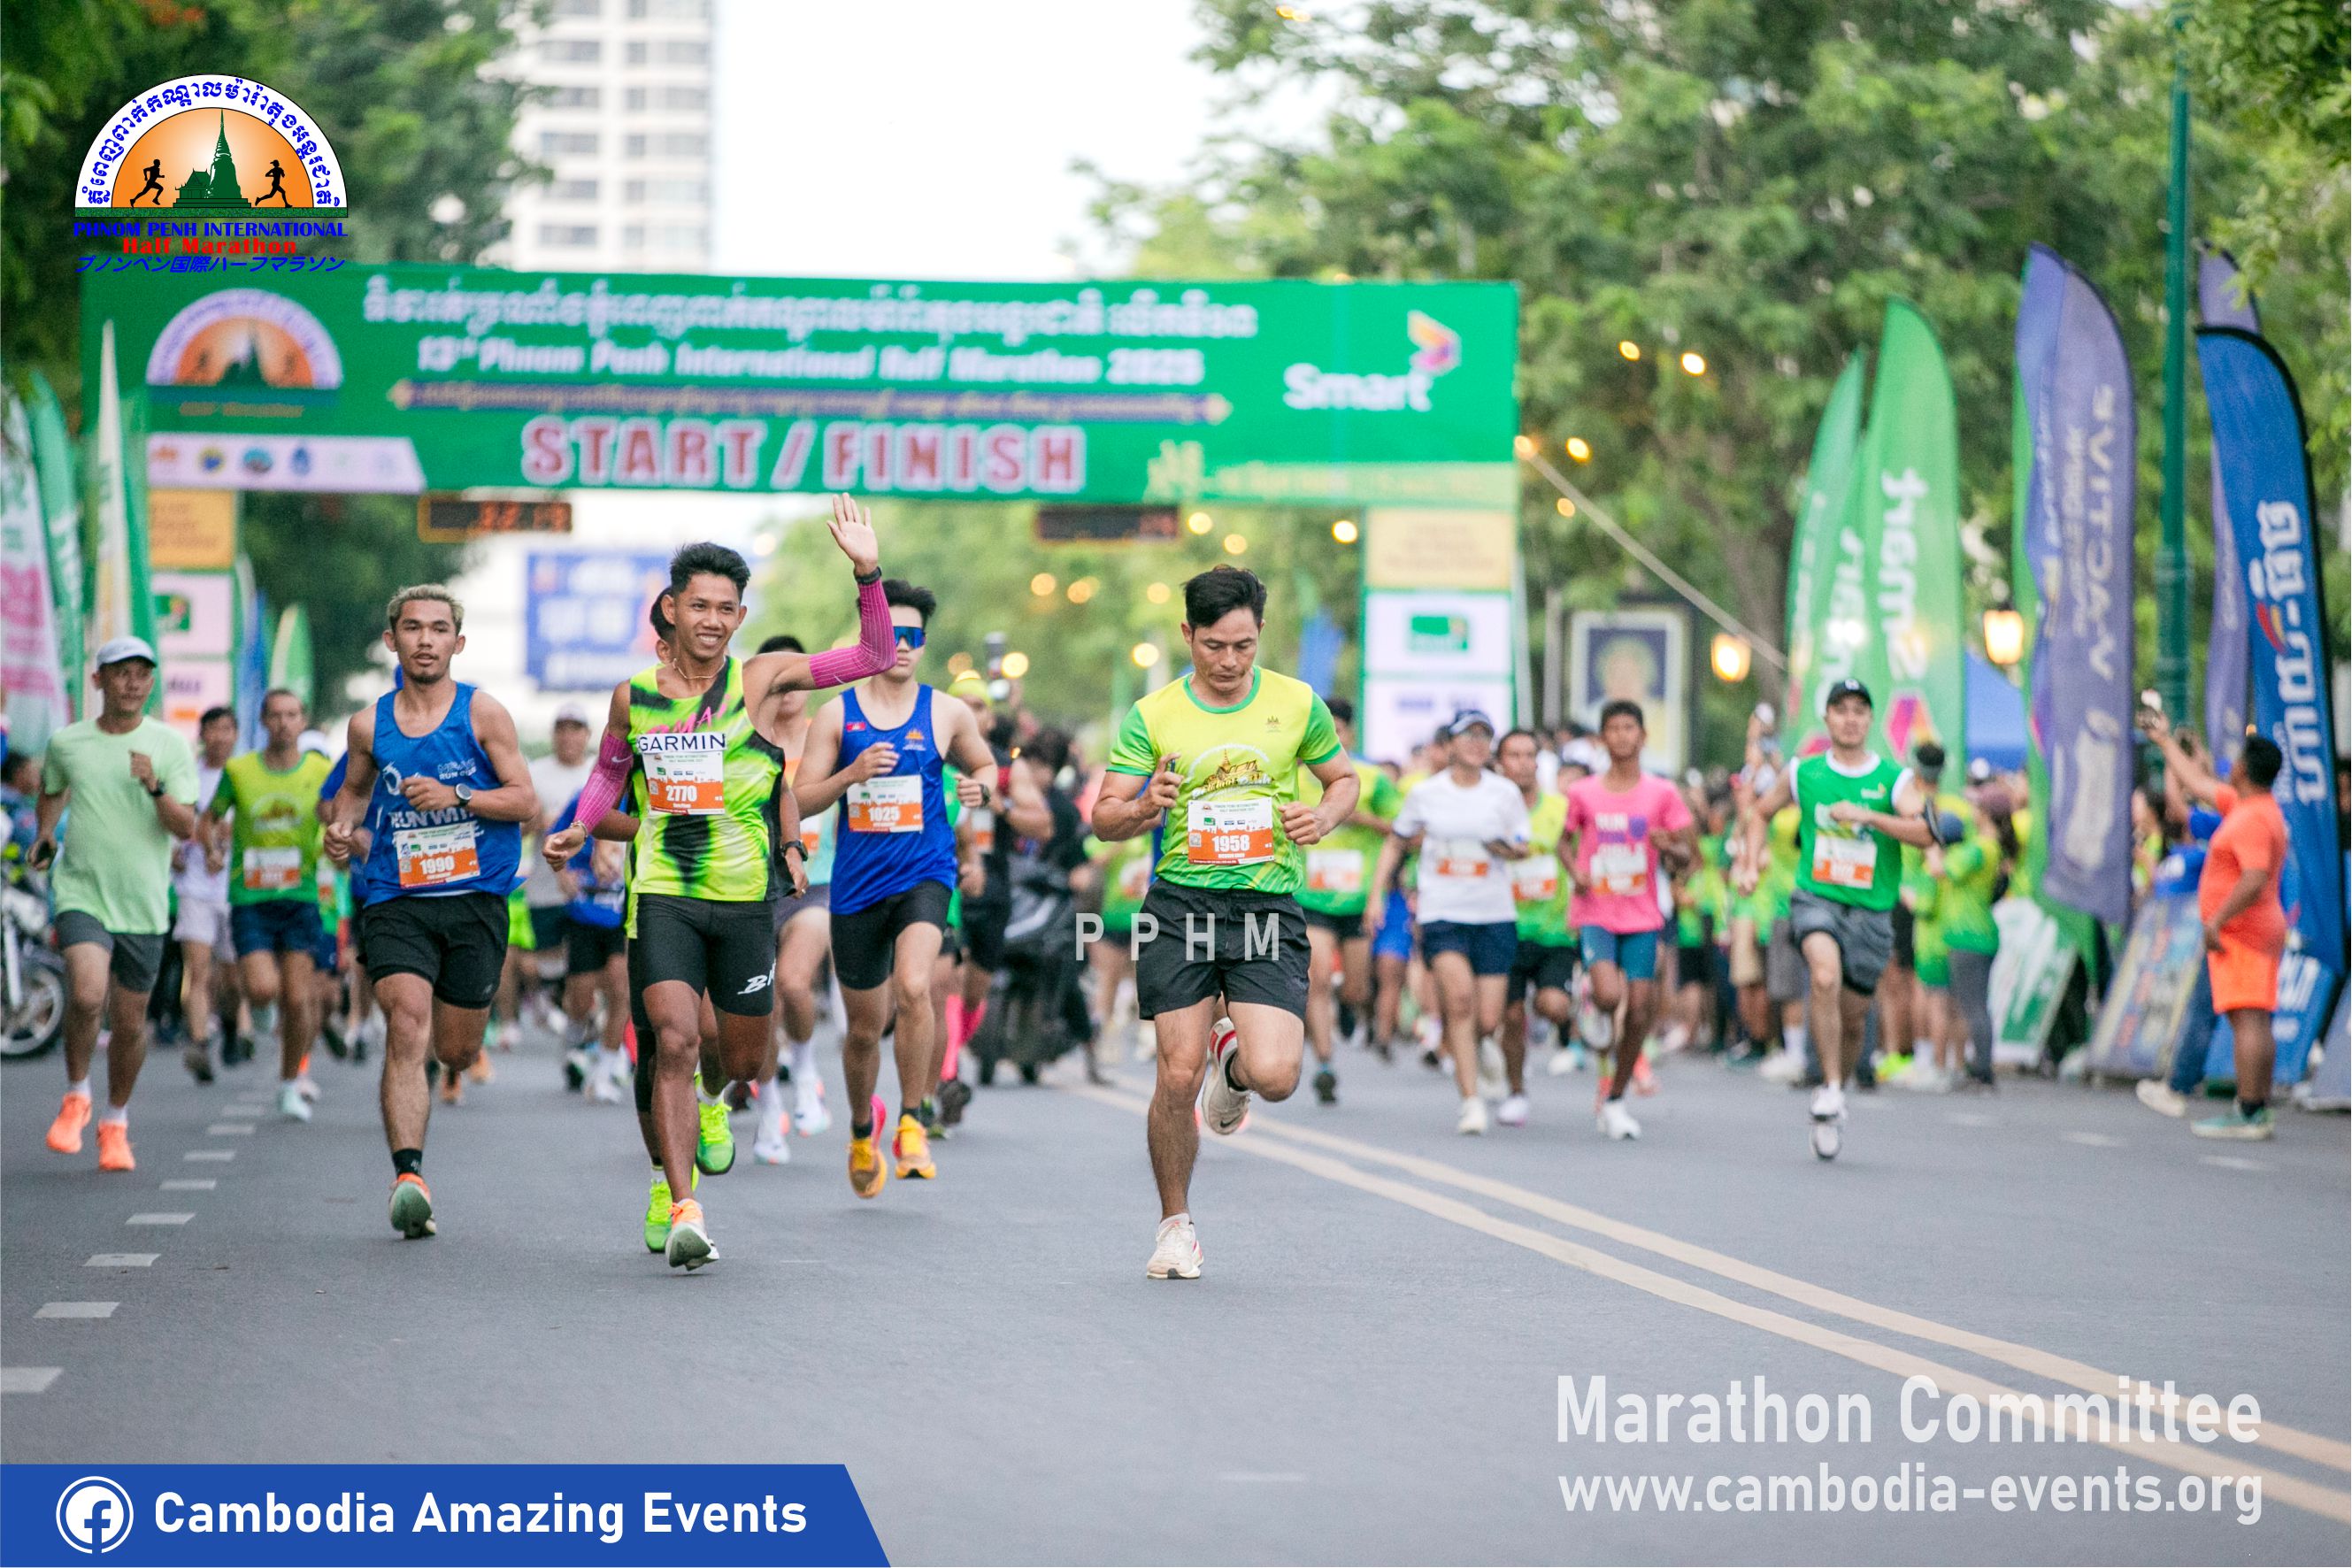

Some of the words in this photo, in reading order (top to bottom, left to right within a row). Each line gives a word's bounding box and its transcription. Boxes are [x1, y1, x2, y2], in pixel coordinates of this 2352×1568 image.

[1283, 363, 1433, 411] Smart
[521, 416, 767, 487] START
[822, 422, 1087, 494] FINISH
[639, 734, 726, 751] GARMIN
[665, 785, 698, 802] 2770
[1211, 834, 1250, 853] 1958
[419, 855, 456, 875] 1990
